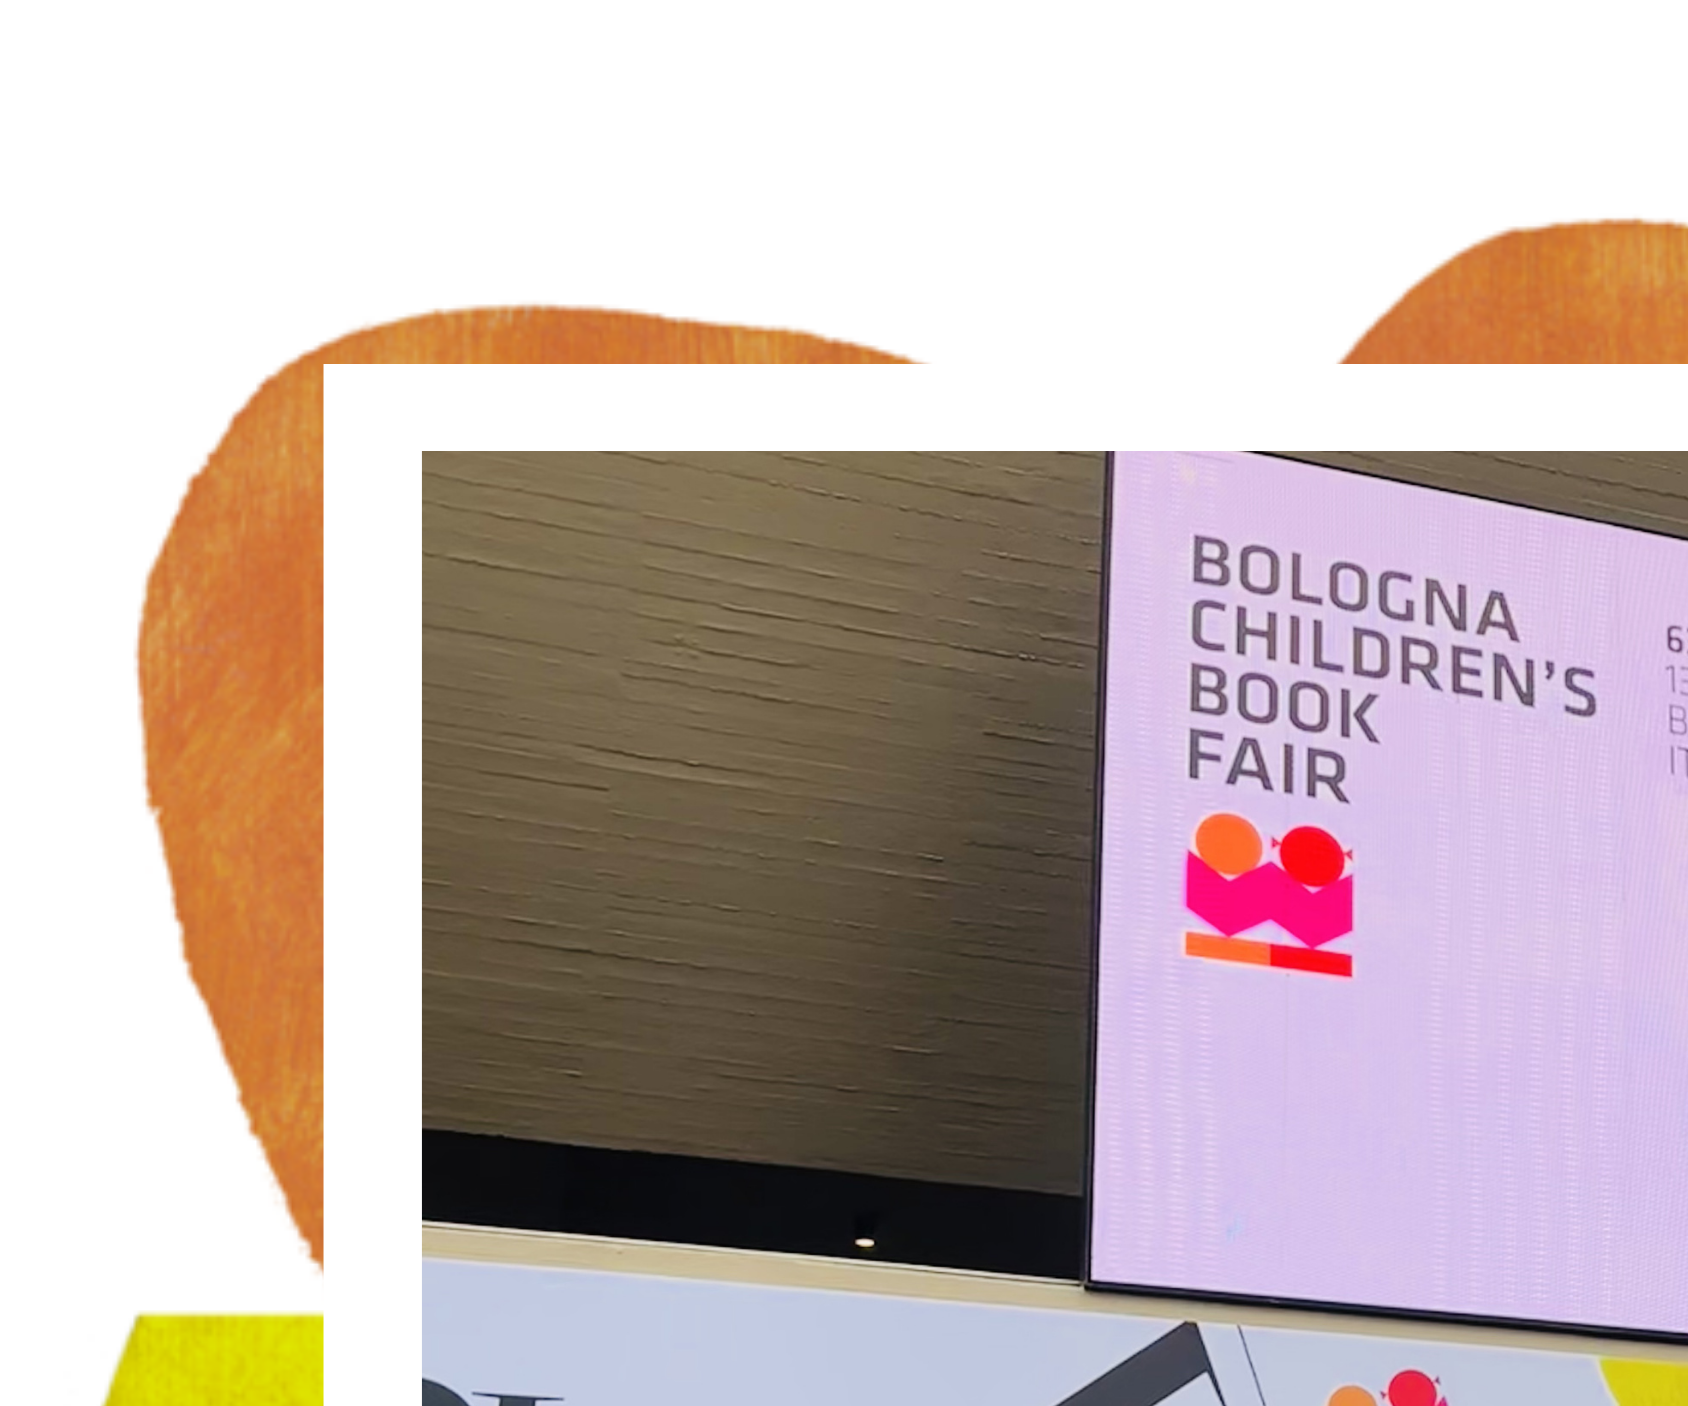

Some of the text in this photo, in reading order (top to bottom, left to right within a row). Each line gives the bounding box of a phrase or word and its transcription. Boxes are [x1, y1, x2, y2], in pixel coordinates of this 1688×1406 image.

[1192, 534, 1520, 641] BOLOGNA
[1189, 662, 1380, 743] BOOK
[1190, 599, 1598, 718] CHILDREN'S
[1188, 728, 1350, 803] FAIR
